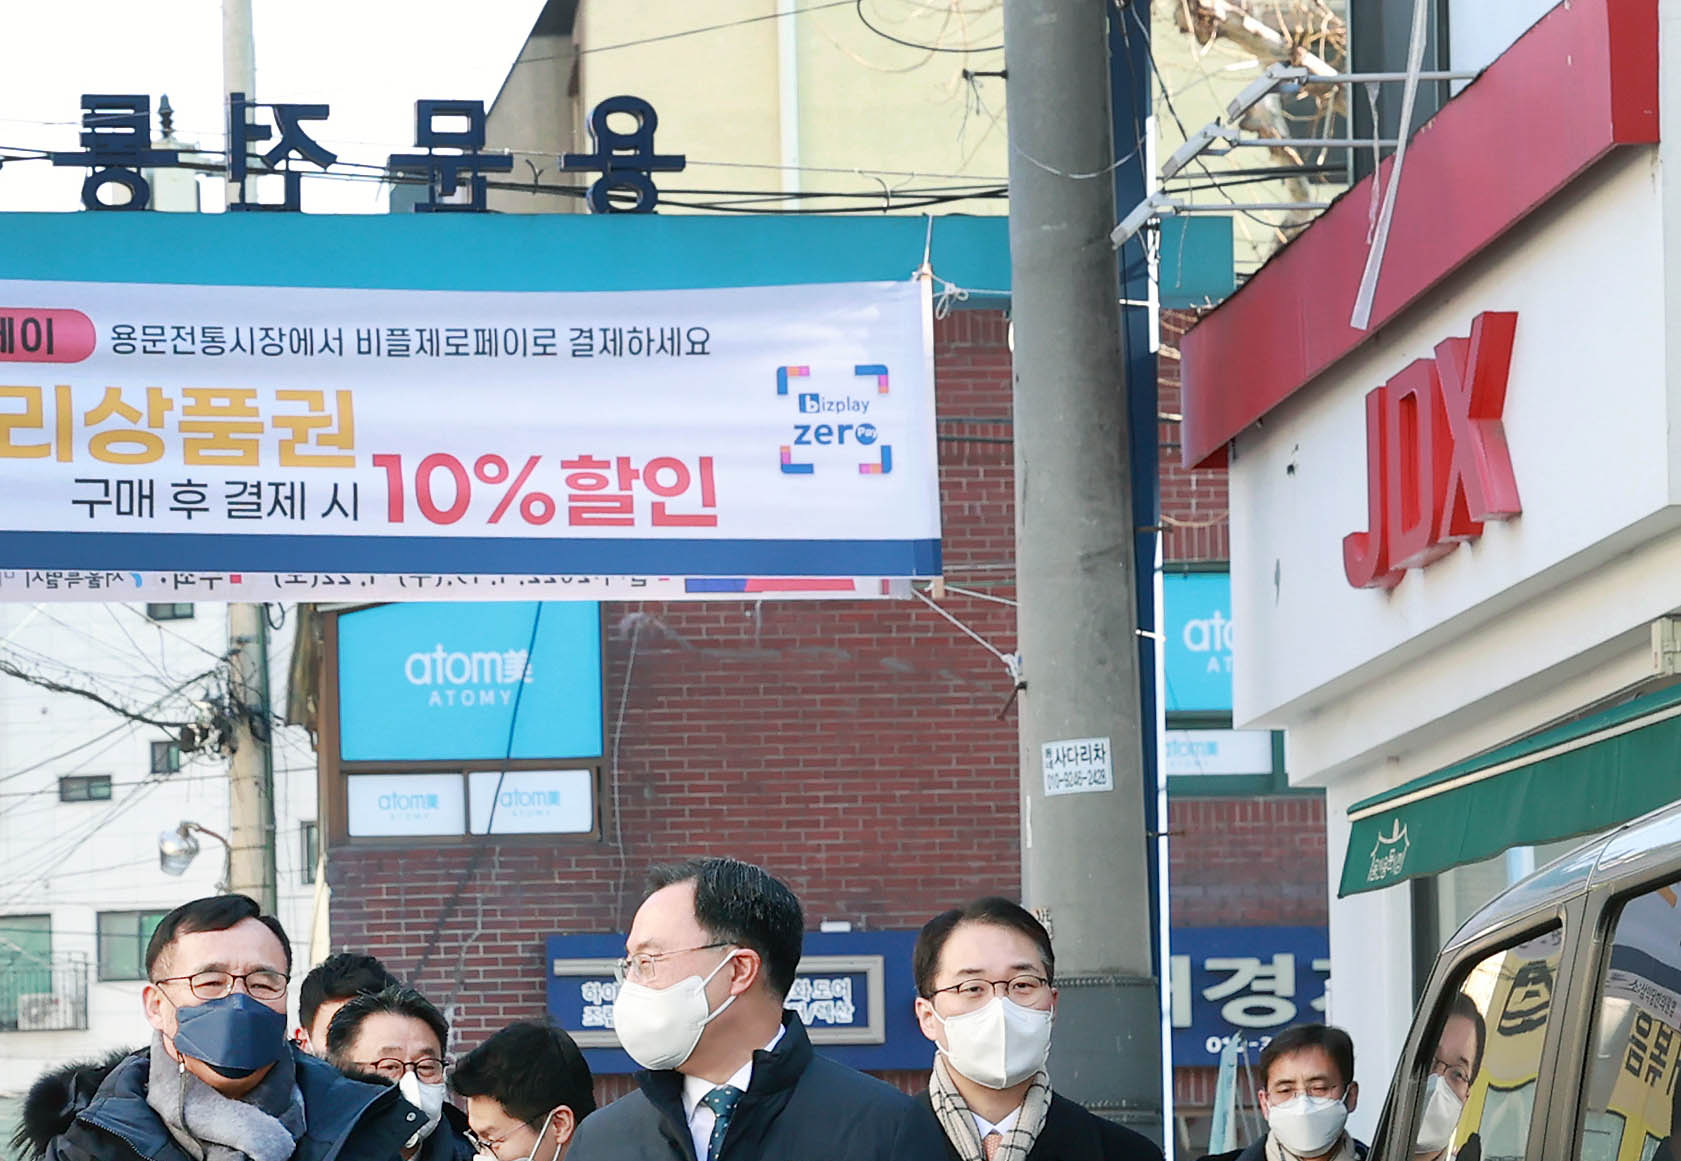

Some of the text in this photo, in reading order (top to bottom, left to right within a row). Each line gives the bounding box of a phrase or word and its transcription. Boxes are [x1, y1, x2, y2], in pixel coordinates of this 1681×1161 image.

[111, 324, 711, 358] 용문전통시장에서 비플제로페이로 결제하세요
[798, 393, 870, 415] bizplay
[1342, 311, 1522, 590] JDX
[72, 451, 718, 528] 구매 후 결제 시 10%할인
[428, 690, 513, 707] ATOMY
[1055, 743, 1106, 768] 사다리차
